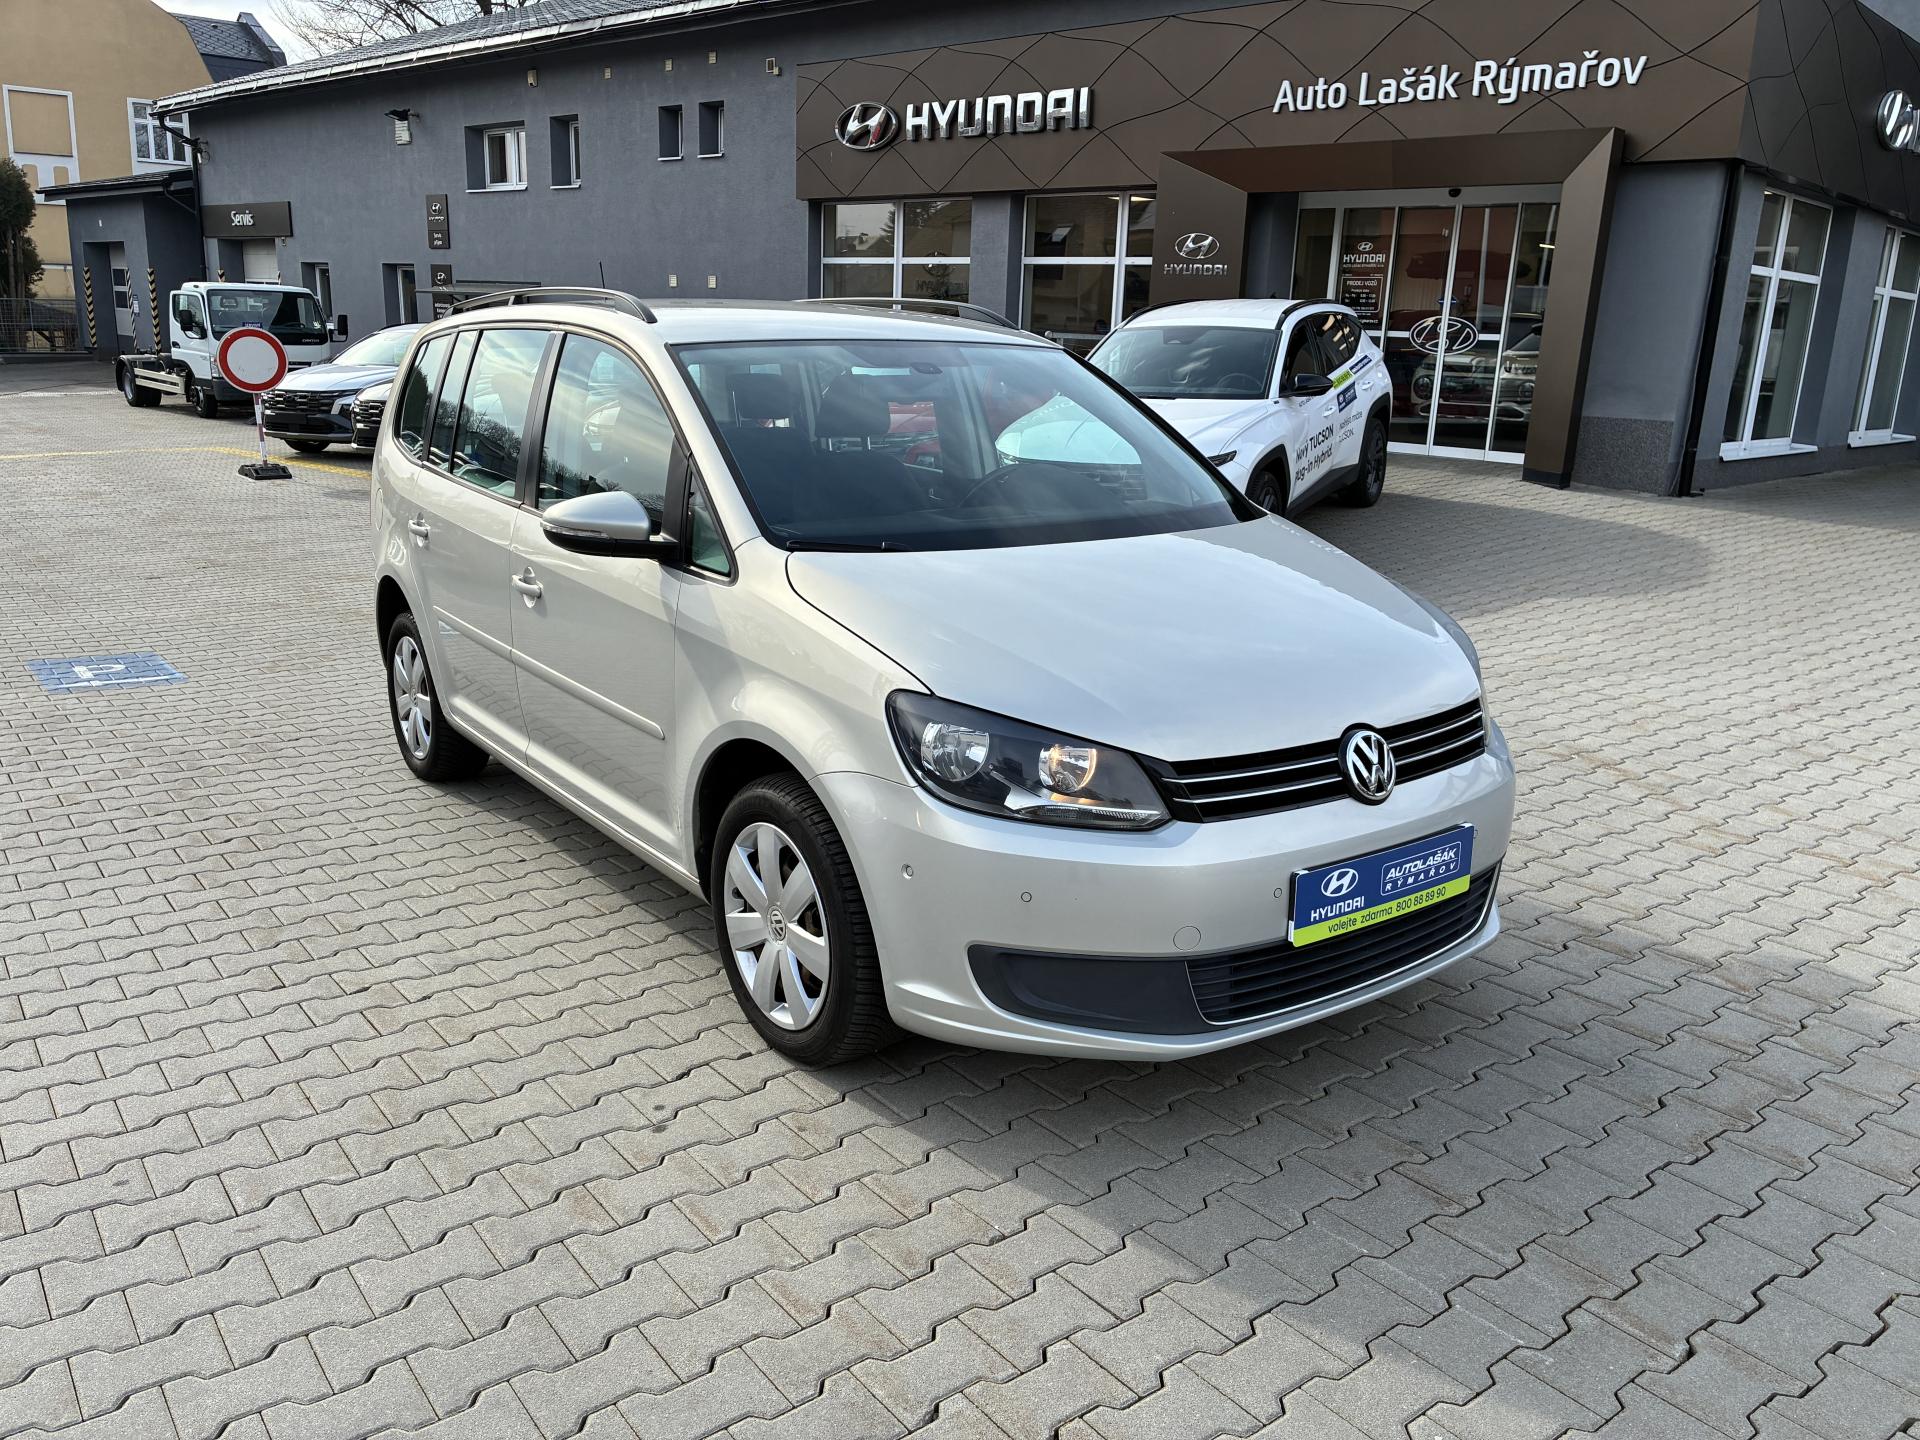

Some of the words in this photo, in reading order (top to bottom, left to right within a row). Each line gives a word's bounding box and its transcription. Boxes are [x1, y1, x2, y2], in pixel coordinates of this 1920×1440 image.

[1272, 77, 1348, 113] Auto
[1357, 63, 1460, 106] Lašák
[1471, 50, 1648, 104] Rýmařov
[905, 86, 1091, 142] HYUNDAI
[230, 210, 254, 226] Servis
[1163, 263, 1228, 276] HYUNDAI
[1343, 253, 1386, 263] HYUNDAI
[1309, 423, 1334, 451] TUCSON
[1386, 848, 1457, 880] AUTOLAŠÁK
[1310, 896, 1364, 922] HYUNDAI
[1328, 917, 1357, 933] volejte
[1360, 907, 1393, 924] zdarma
[1395, 898, 1412, 912] 800
[1413, 894, 1424, 906] 88
[1424, 891, 1435, 902] 89
[1436, 886, 1446, 899] 90
